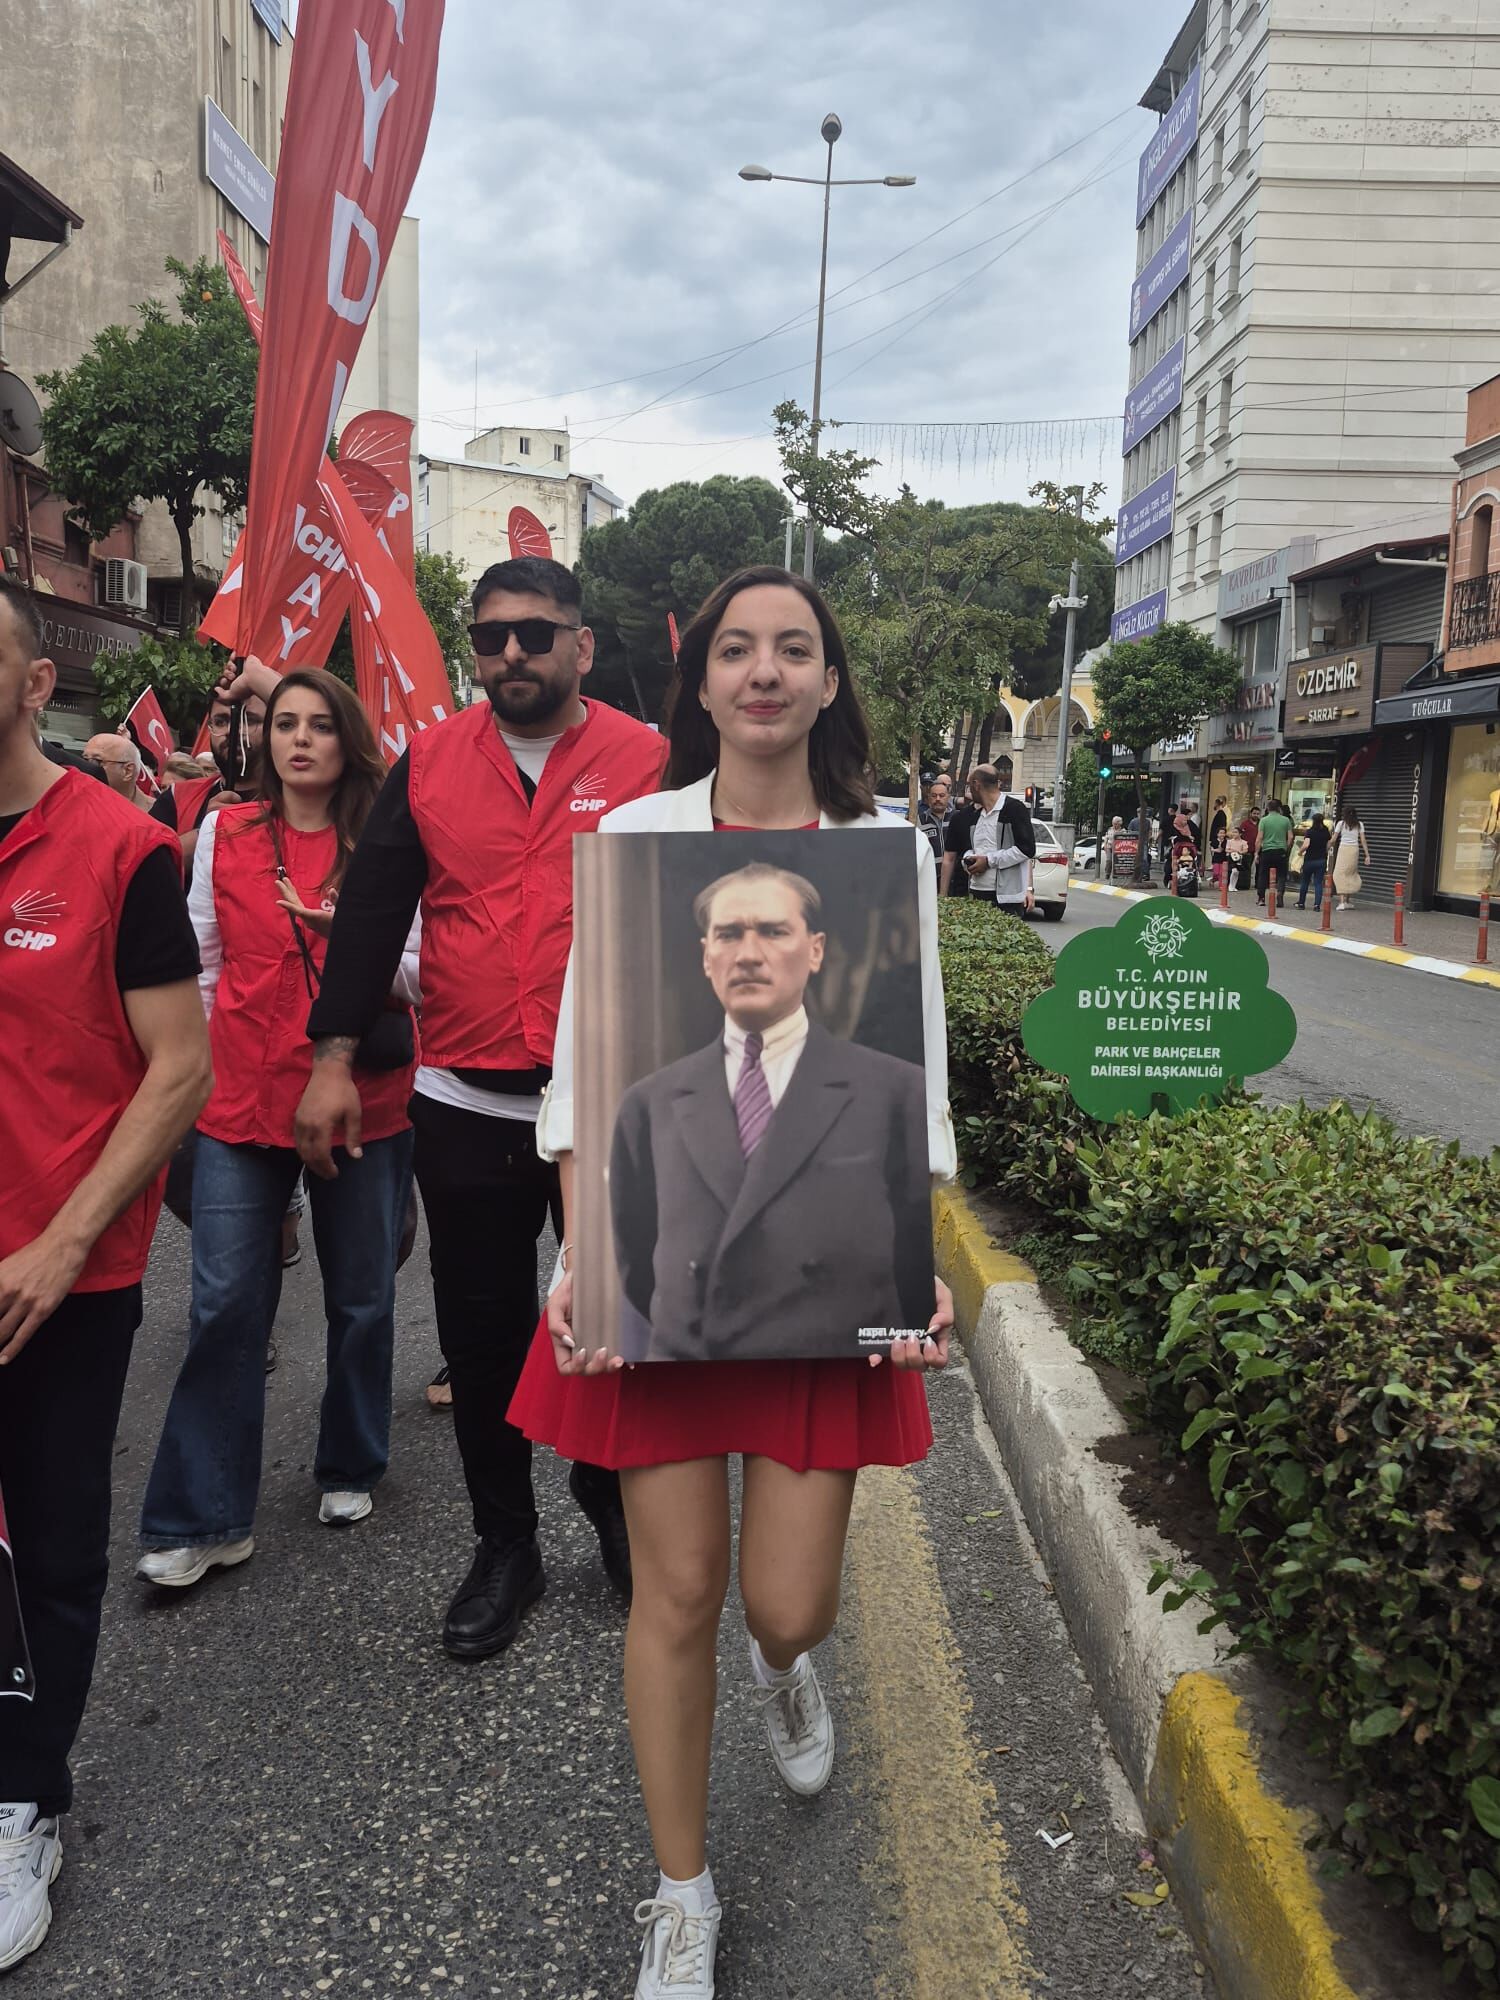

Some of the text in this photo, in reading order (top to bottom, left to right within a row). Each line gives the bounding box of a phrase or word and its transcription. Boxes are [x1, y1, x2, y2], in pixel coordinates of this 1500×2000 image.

[1136, 604, 1160, 633] KÜLTÜR
[1296, 656, 1358, 697] ÖZDEMİR
[1308, 706, 1339, 723] SARRAF
[1412, 699, 1452, 717] TUĞCULAR
[570, 798, 608, 812] CHP
[3, 927, 57, 951] CHP
[1116, 968, 1208, 983] T.C. AYDIN
[1078, 986, 1241, 1015] BÜYÜKŞEHİR
[1106, 1015, 1211, 1032] BELEDİYESİ
[1094, 1046, 1221, 1061] PARK VE BAHÇELER
[1091, 1063, 1223, 1080] DAİRESİ BAŞKANLIĞI
